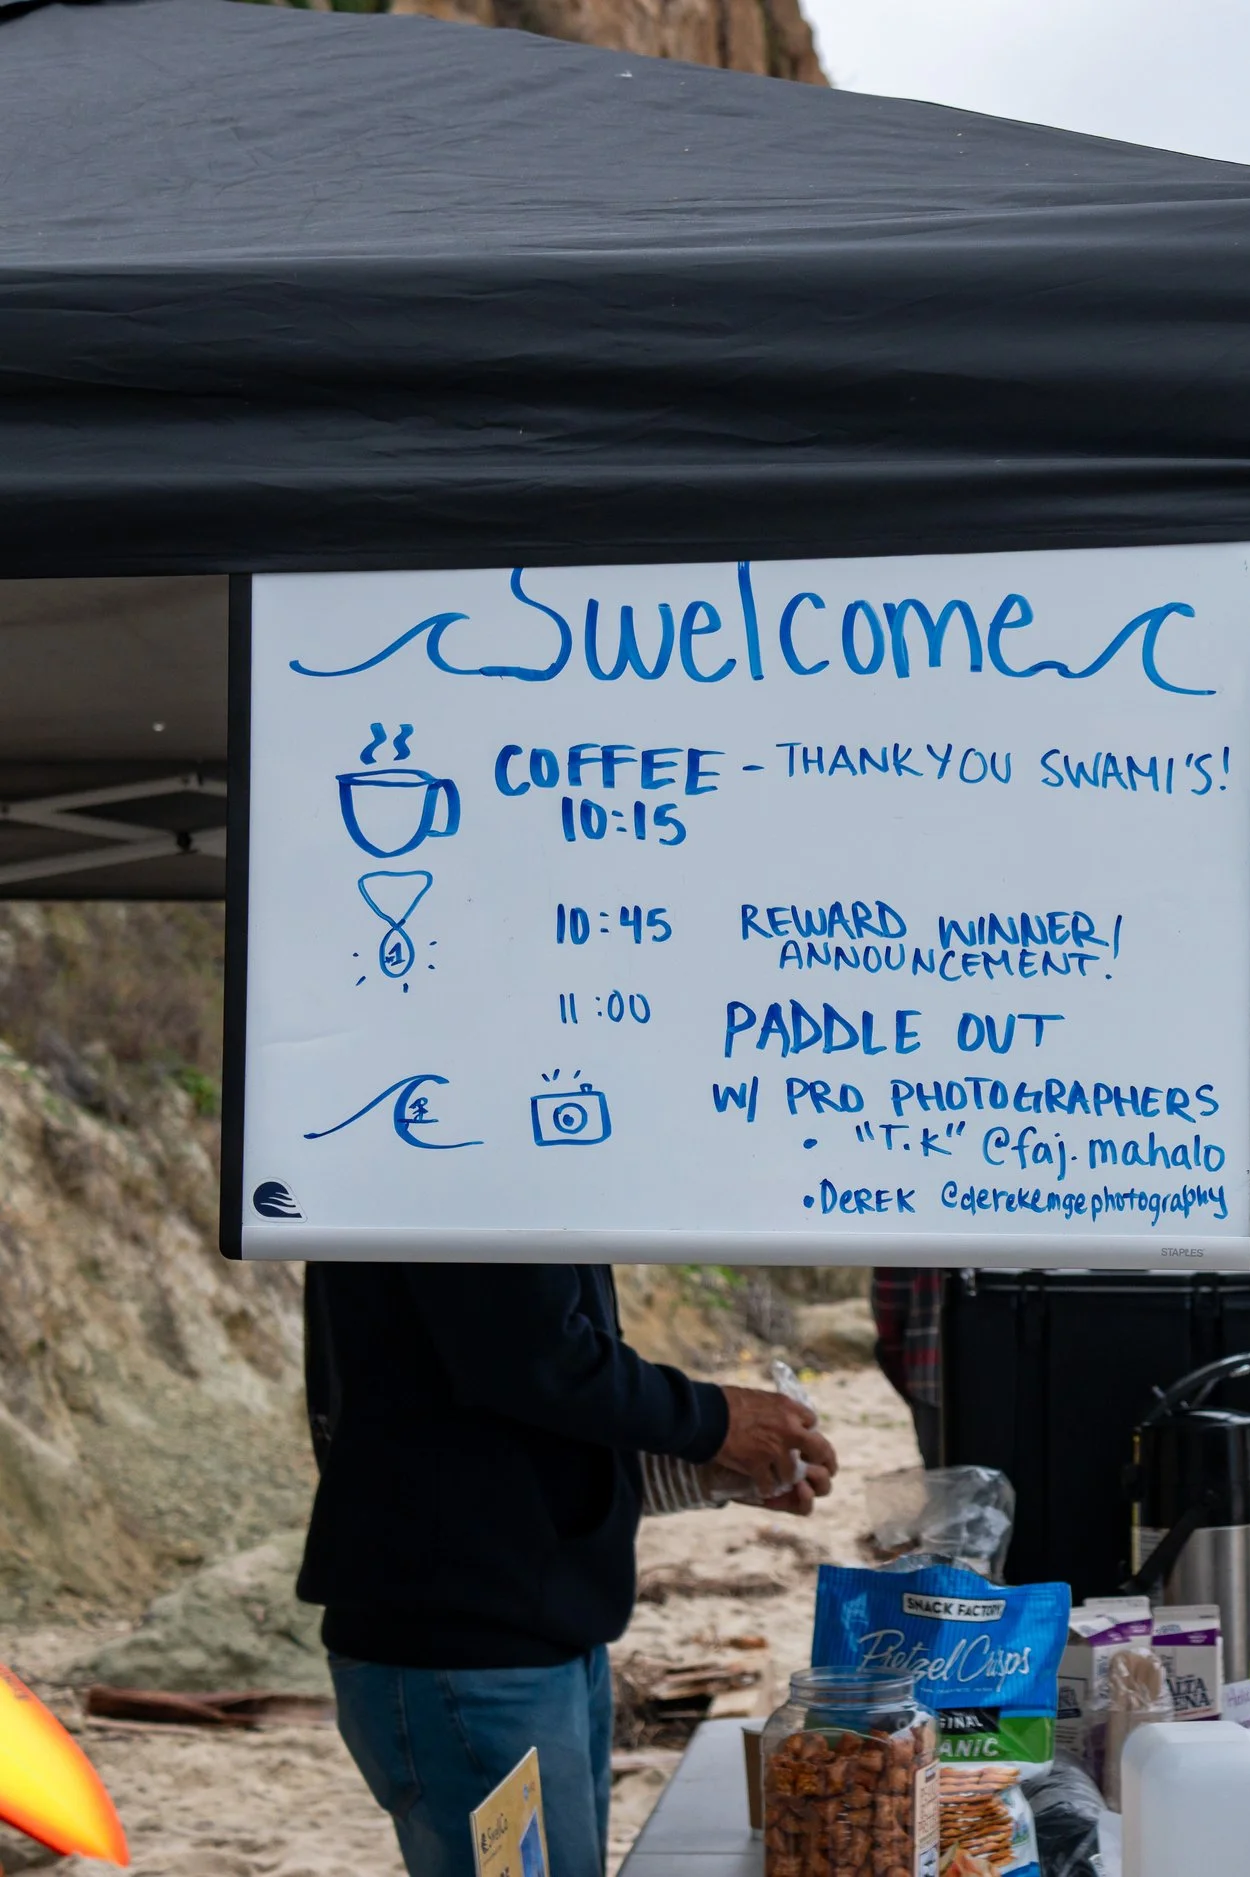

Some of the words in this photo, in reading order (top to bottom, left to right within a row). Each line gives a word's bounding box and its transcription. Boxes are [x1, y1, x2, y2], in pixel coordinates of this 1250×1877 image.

[480, 560, 1034, 684] Swelcome
[494, 743, 724, 797] COFFEE
[1039, 746, 1231, 797] SWAMI'S!
[561, 796, 688, 848] 10:15
[556, 904, 673, 946] 10:45
[740, 899, 909, 942] REWARD
[559, 988, 652, 1025] 11:00
[724, 998, 923, 1060] PADDLE
[957, 1011, 1066, 1056] OUT
[712, 1075, 759, 1125] W/
[785, 1076, 865, 1117] PRO
[890, 1076, 1221, 1124] PHOTOGRAPHERS
[1160, 1247, 1204, 1258] STAPLES
[907, 1597, 953, 1615] SNACK
[857, 1628, 967, 1684] Pretzel
[957, 1634, 1032, 1693] Crisps
